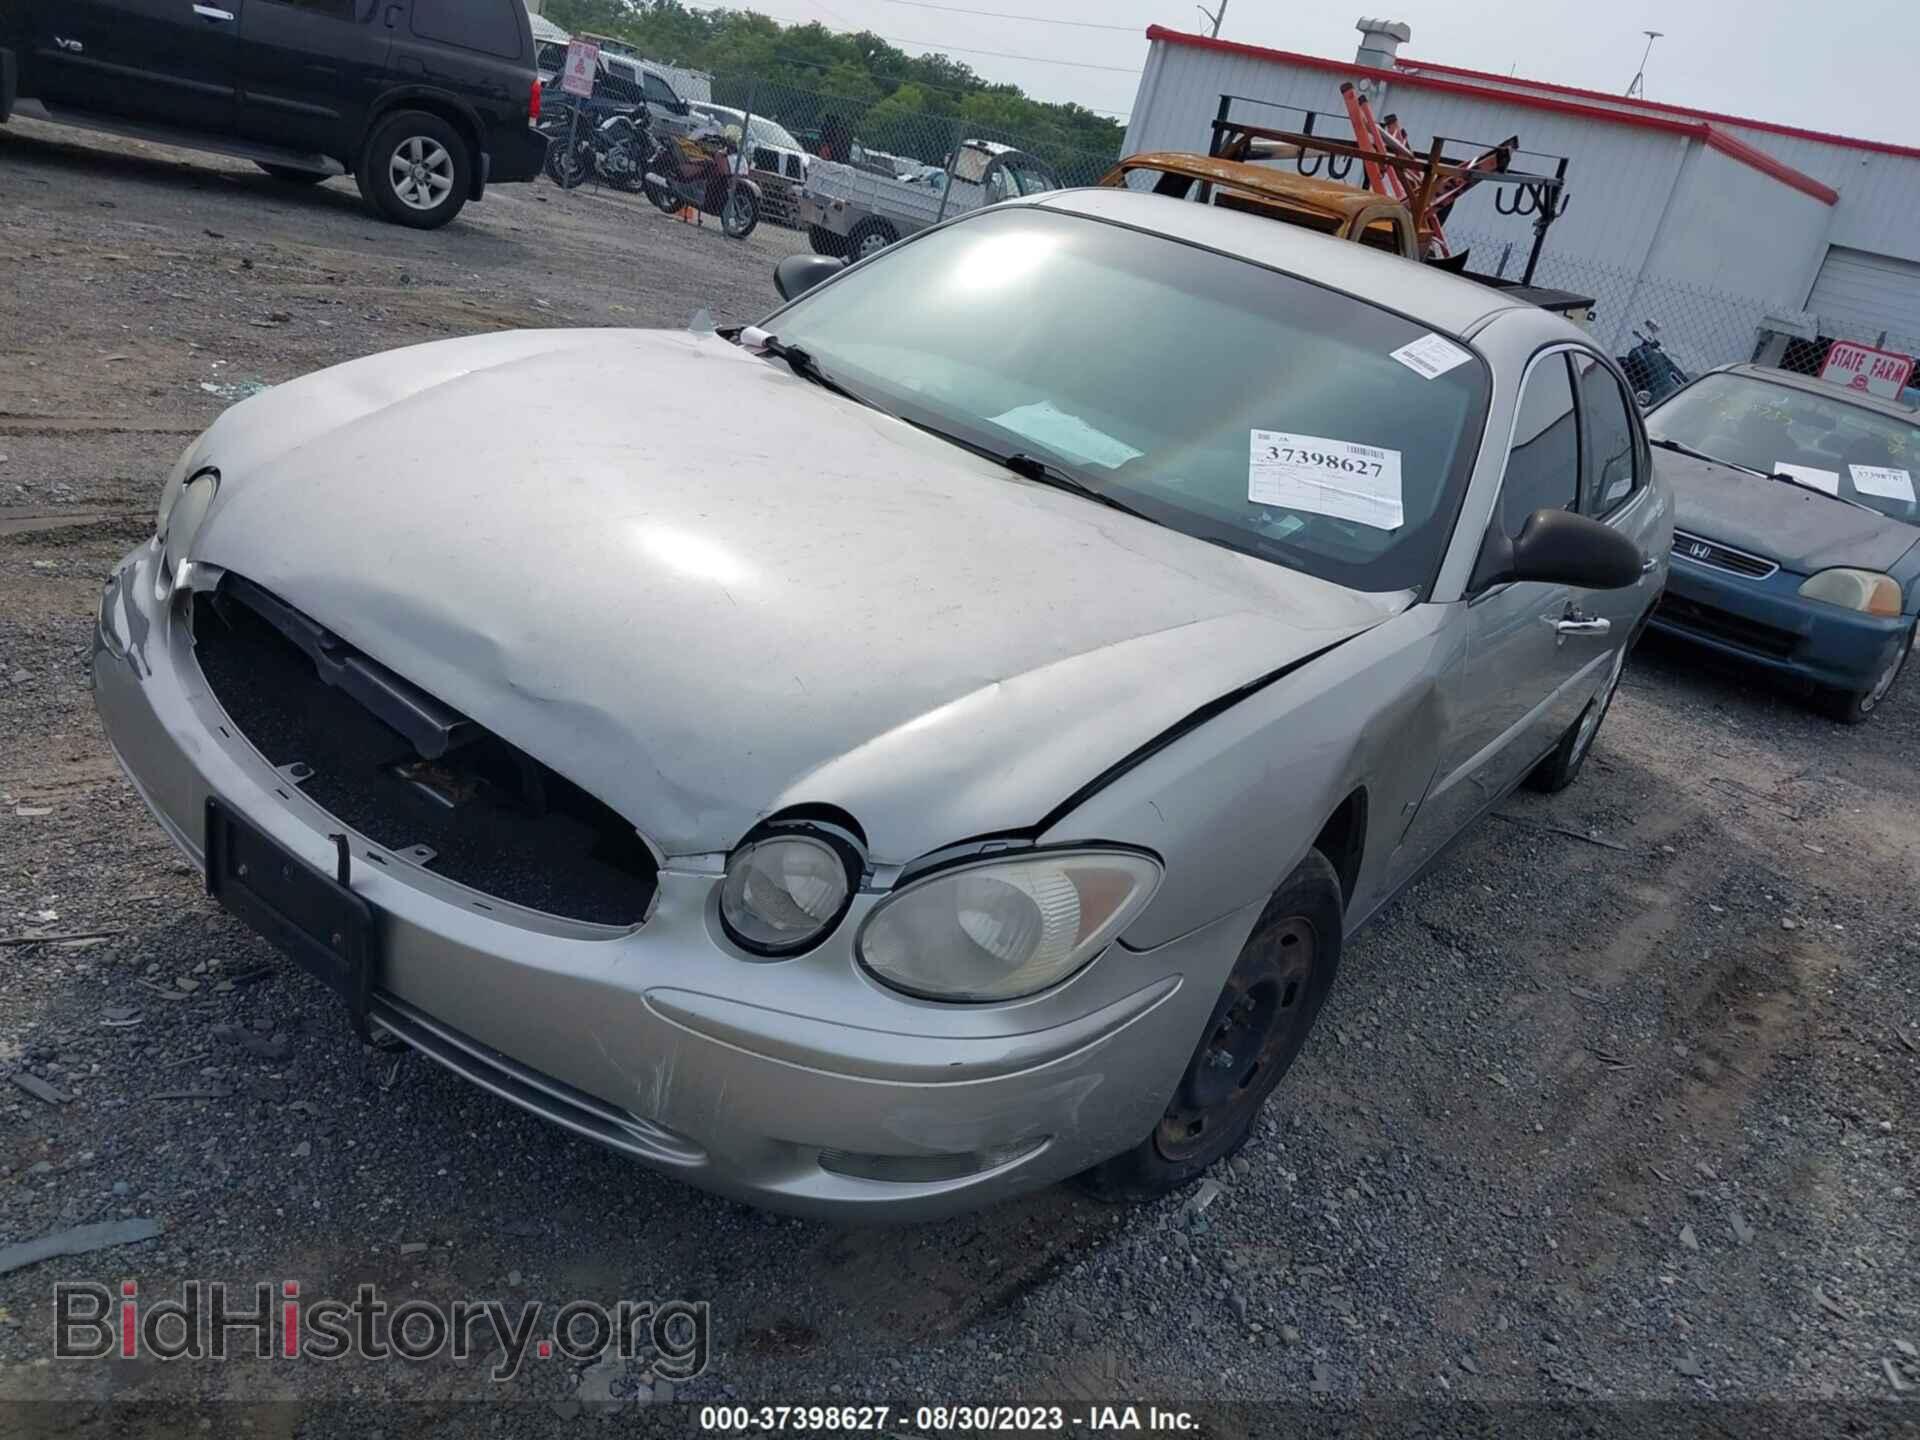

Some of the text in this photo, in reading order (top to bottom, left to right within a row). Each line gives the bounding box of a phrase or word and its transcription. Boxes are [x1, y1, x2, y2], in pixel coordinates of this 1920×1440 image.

[1830, 347, 1907, 384] STATE FARM
[1266, 446, 1382, 478] 37398627
